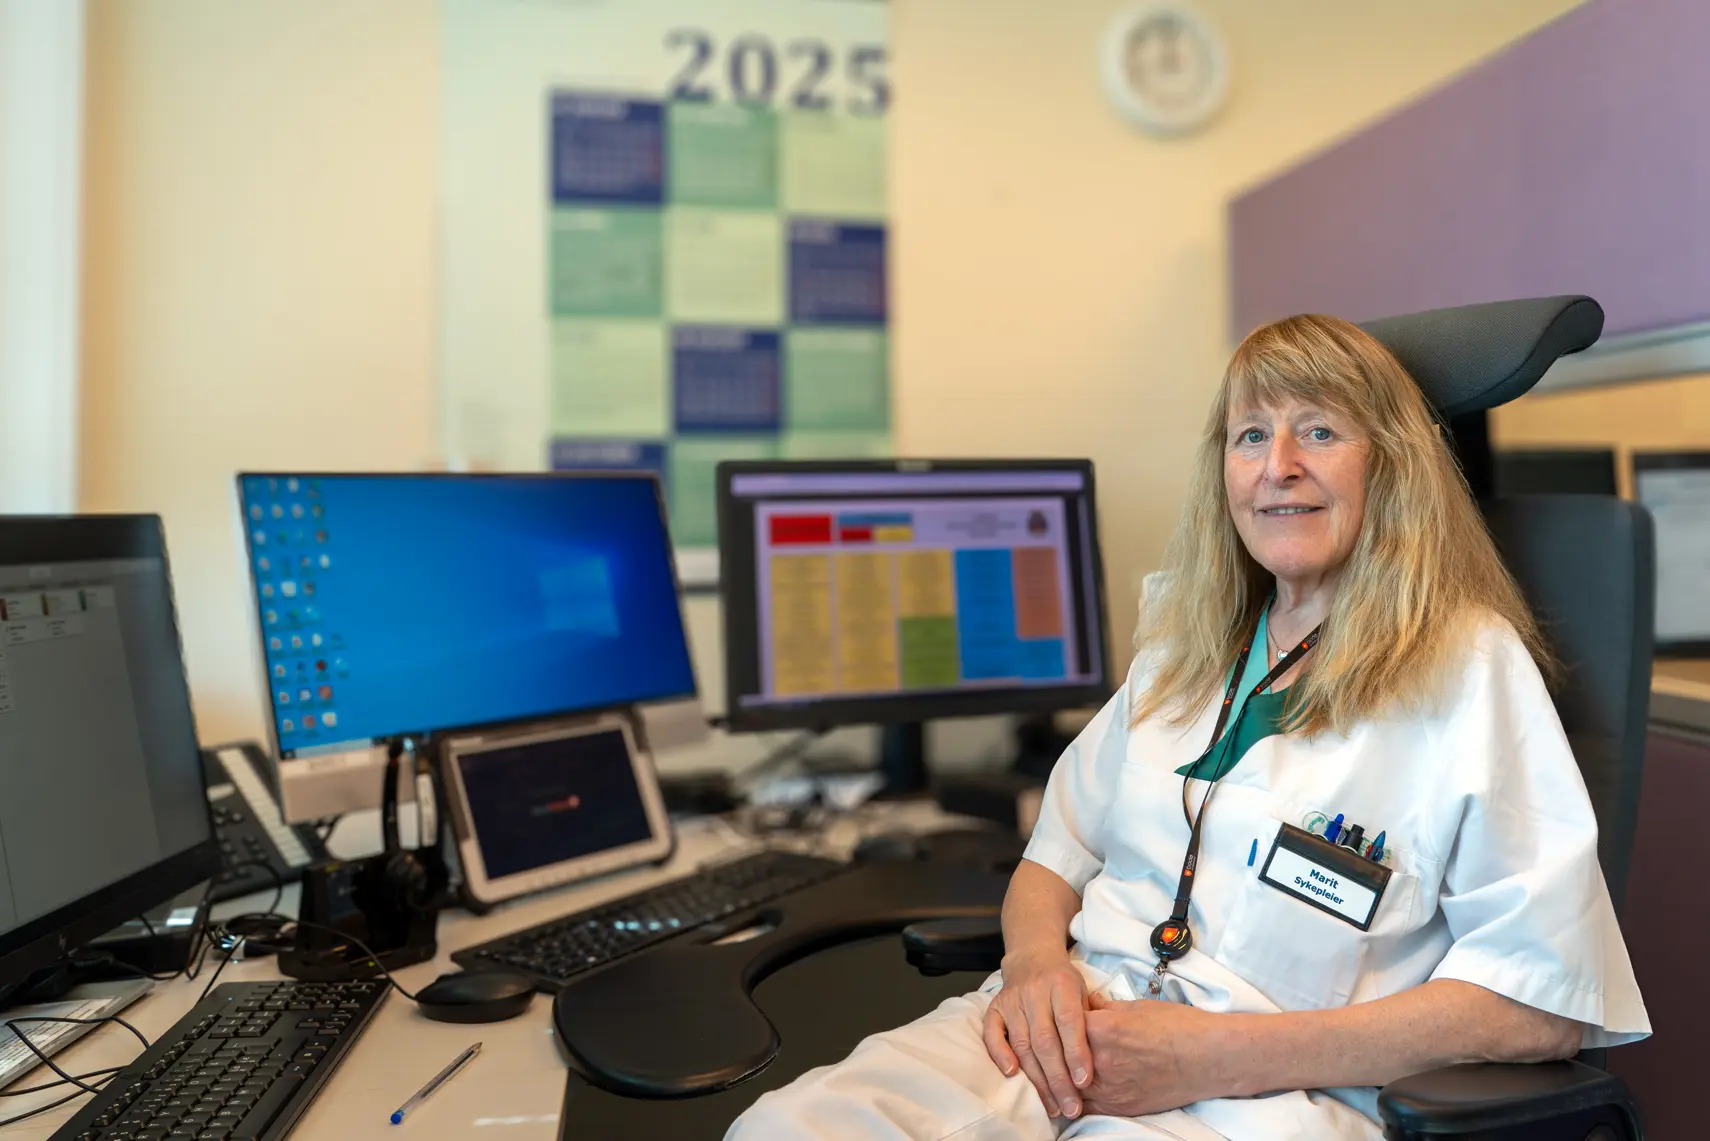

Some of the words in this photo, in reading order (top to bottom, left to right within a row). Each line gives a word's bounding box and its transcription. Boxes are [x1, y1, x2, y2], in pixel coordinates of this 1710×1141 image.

[665, 28, 892, 117] 2025
[1294, 876, 1344, 904] Sykepleier
[1309, 868, 1339, 889] Marit
